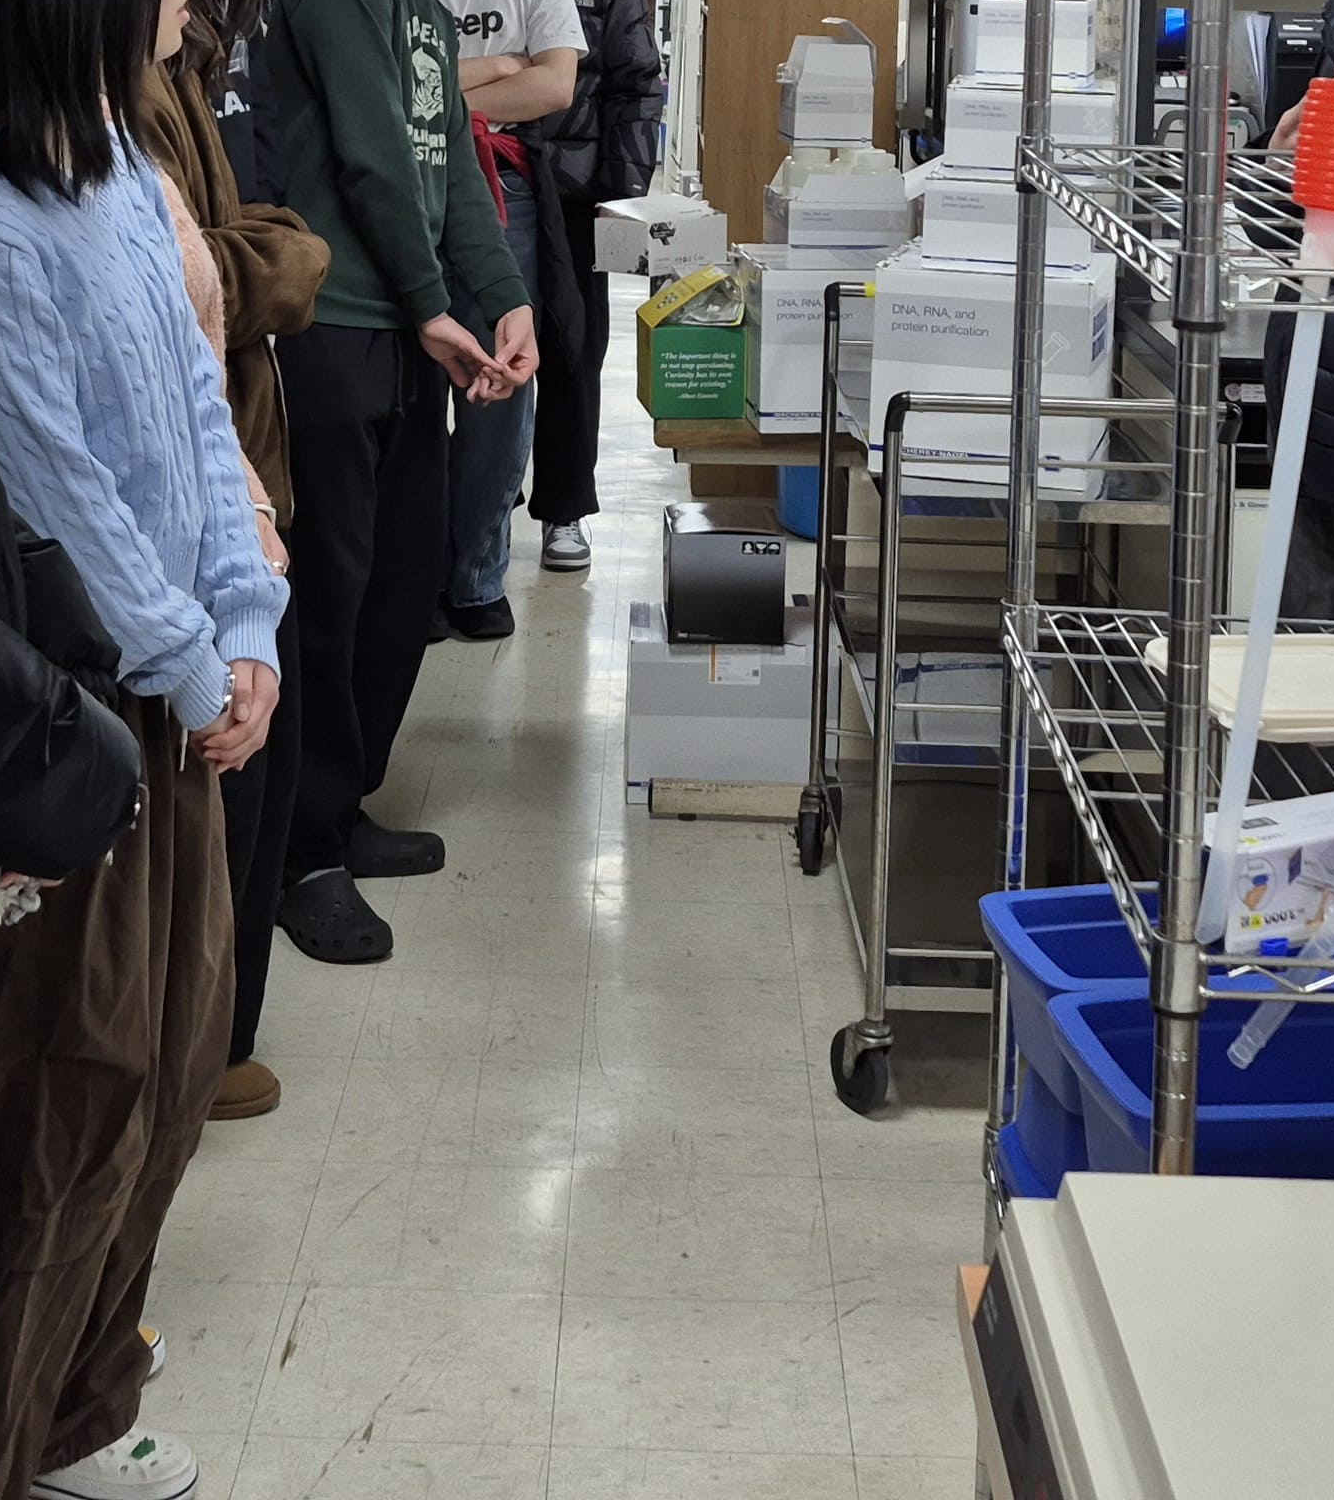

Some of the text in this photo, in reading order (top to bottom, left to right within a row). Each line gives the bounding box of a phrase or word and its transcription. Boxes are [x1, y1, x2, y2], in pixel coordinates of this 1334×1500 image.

[776, 298, 799, 309] DNA,
[776, 311, 806, 322] protein
[892, 303, 976, 321] DNA, RNA, and
[891, 321, 989, 338] protein purification
